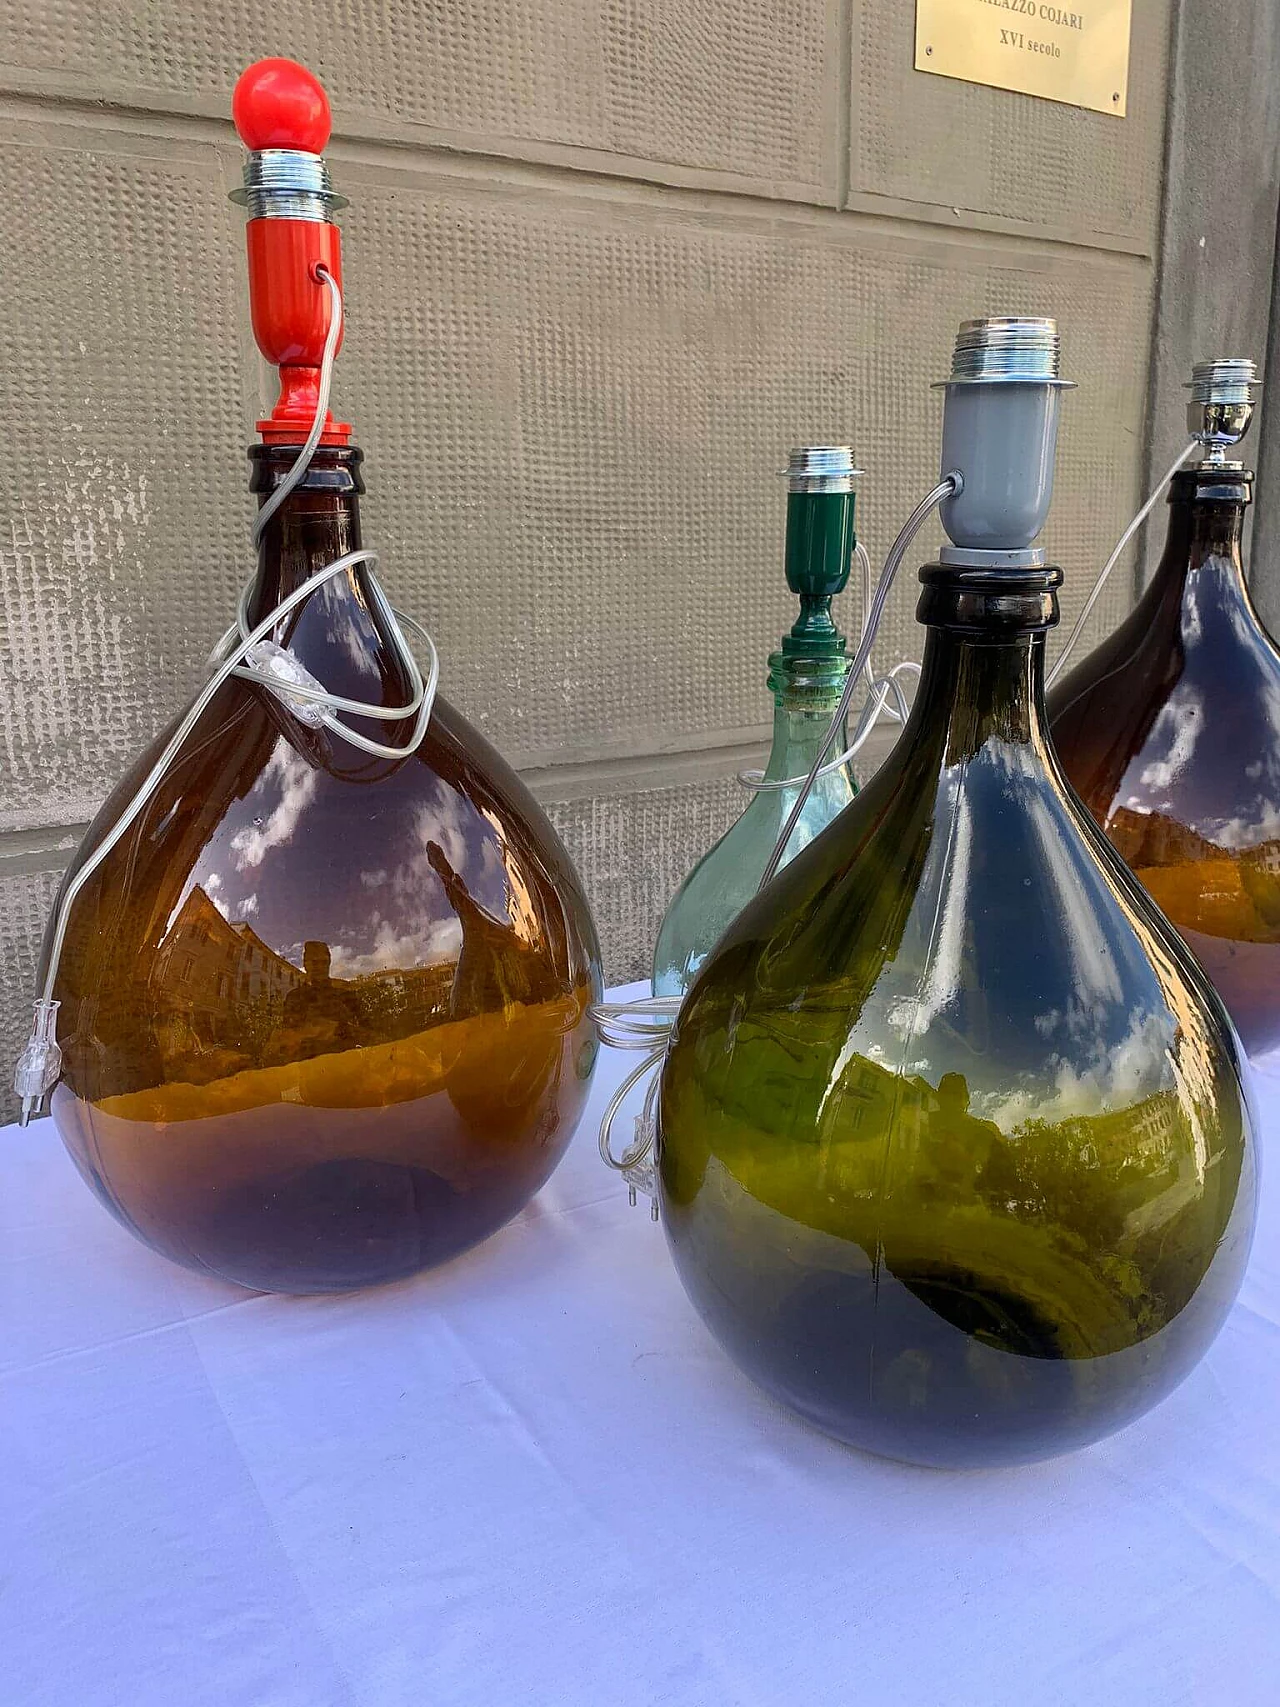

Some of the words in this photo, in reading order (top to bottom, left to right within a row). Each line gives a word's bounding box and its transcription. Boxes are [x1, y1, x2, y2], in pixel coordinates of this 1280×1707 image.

[979, 0, 1036, 16] AZZO
[1040, 5, 1083, 30] COJARI
[1000, 29, 1024, 48] XVI
[1028, 40, 1061, 58] secolo
